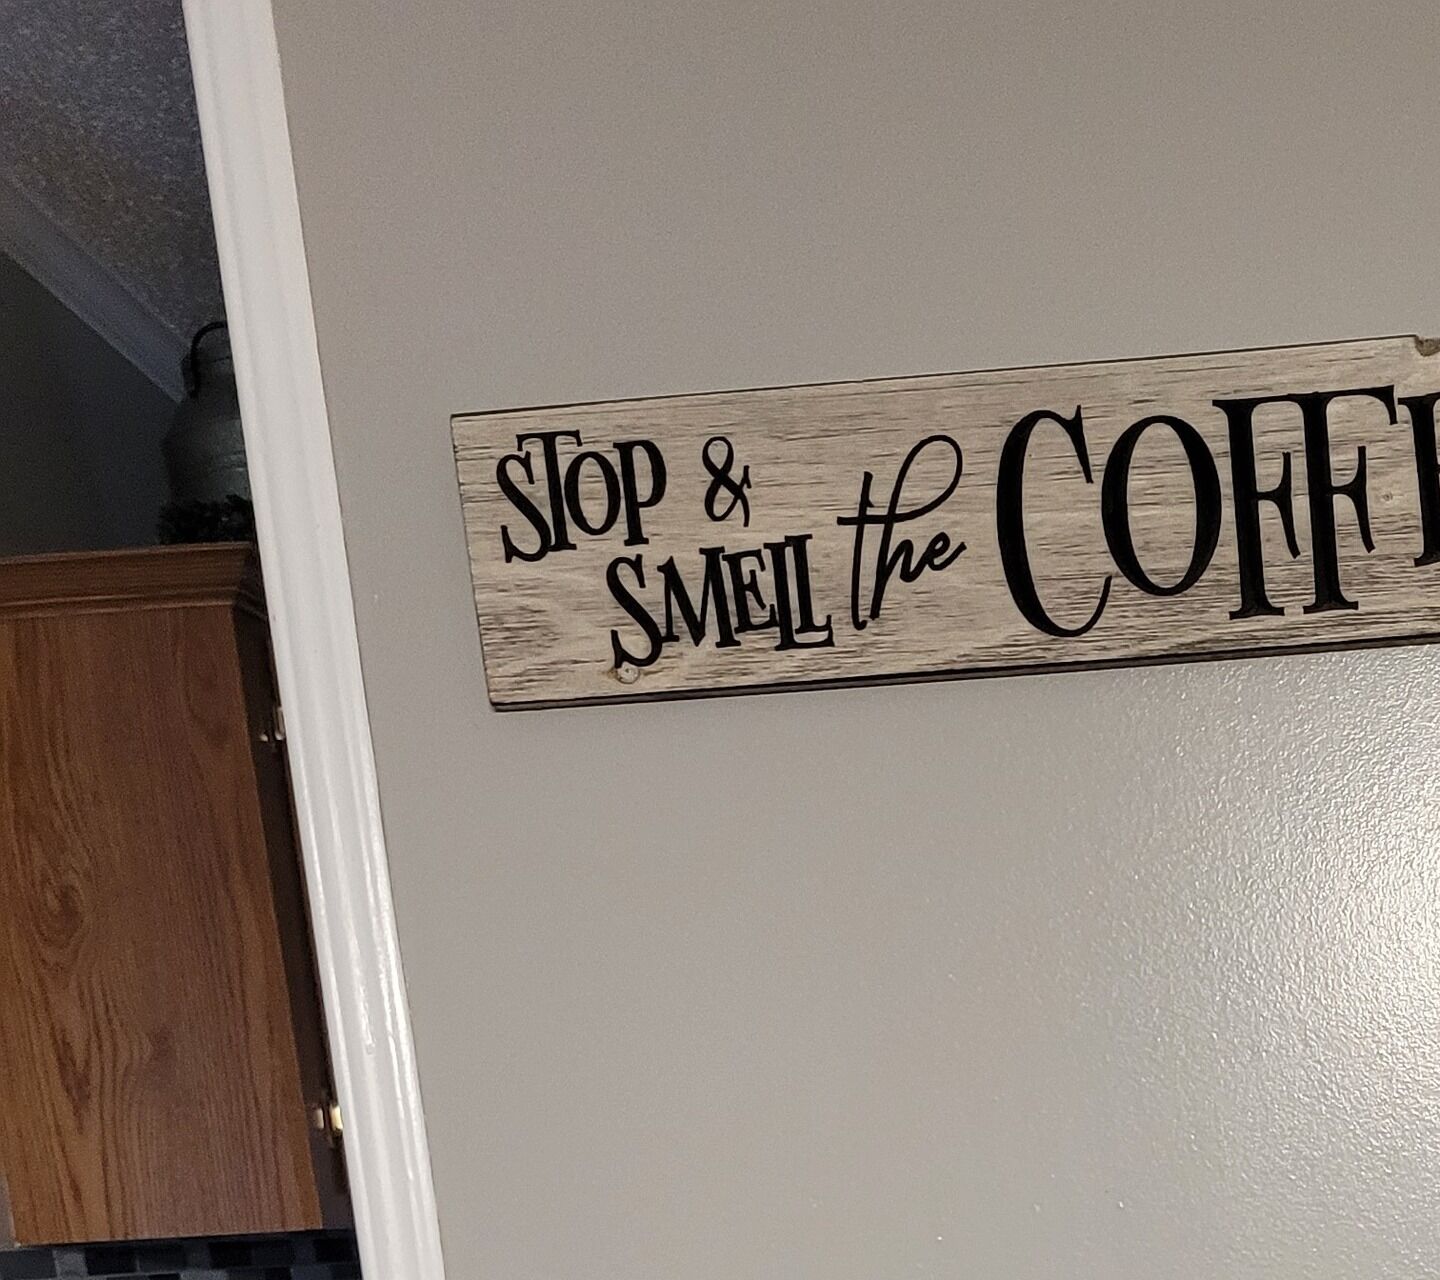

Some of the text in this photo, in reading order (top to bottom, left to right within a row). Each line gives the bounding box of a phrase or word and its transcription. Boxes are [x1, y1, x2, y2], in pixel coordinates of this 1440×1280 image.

[496, 429, 752, 564] STOP &
[606, 533, 836, 668] SMELL
[836, 434, 967, 631] the
